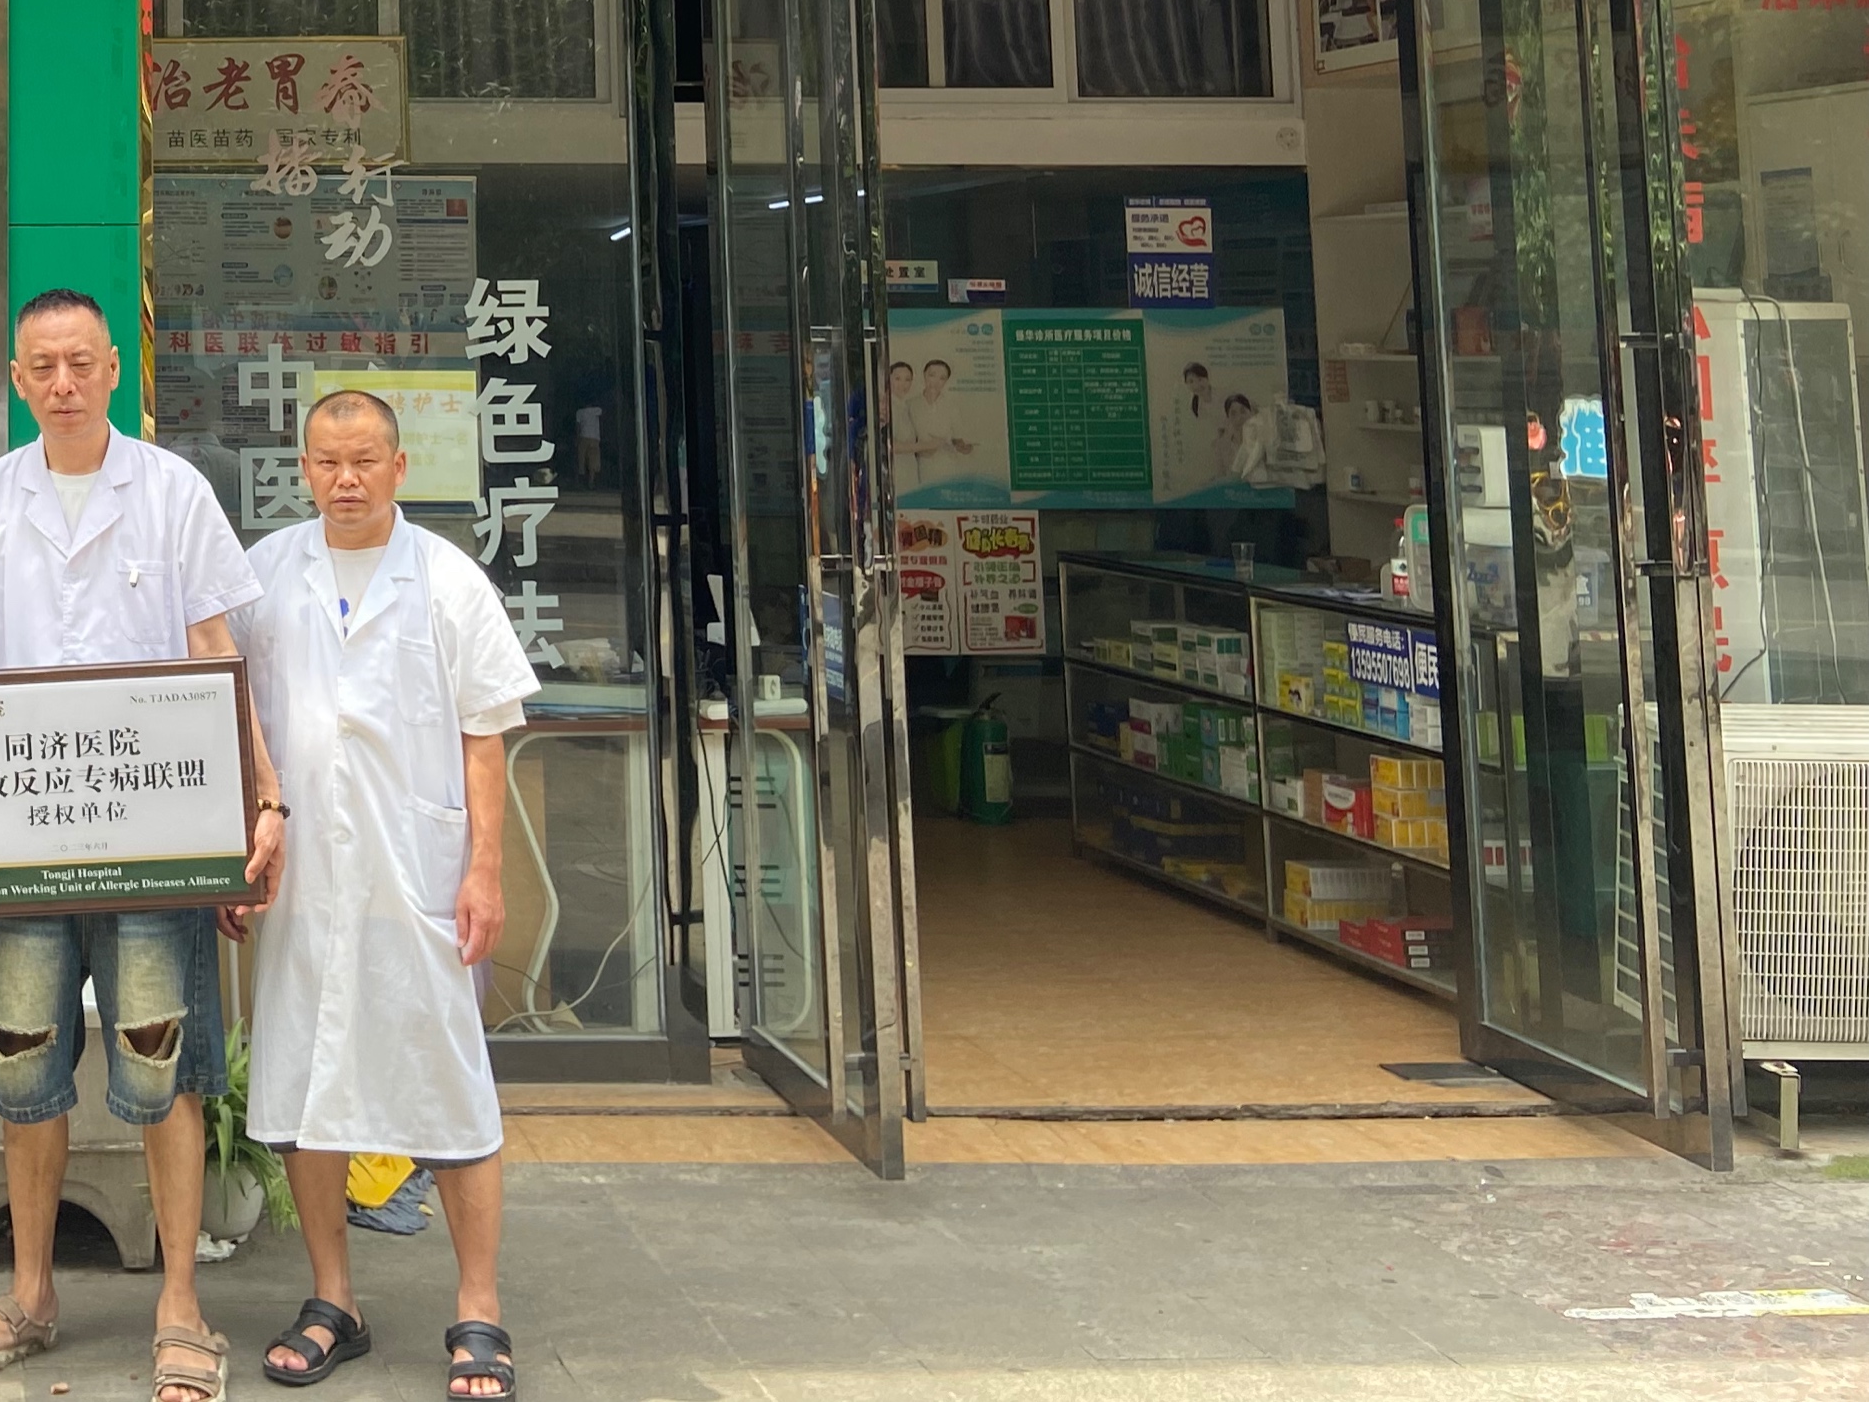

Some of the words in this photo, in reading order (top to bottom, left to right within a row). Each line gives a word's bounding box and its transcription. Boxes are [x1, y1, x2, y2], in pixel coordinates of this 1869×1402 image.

[1134, 263, 1209, 299] 诚信经营
[149, 691, 217, 705] TJADA30877
[4, 727, 141, 762] 同济医院
[28, 802, 128, 827] 授权单位
[10, 882, 57, 897] Working
[59, 880, 81, 893] Unit
[84, 879, 96, 891] of
[98, 877, 140, 893] Allergic
[141, 876, 186, 889] Diseases
[188, 874, 231, 888] Alliance
[41, 869, 75, 881] Tongji
[78, 866, 122, 879] Hospital
